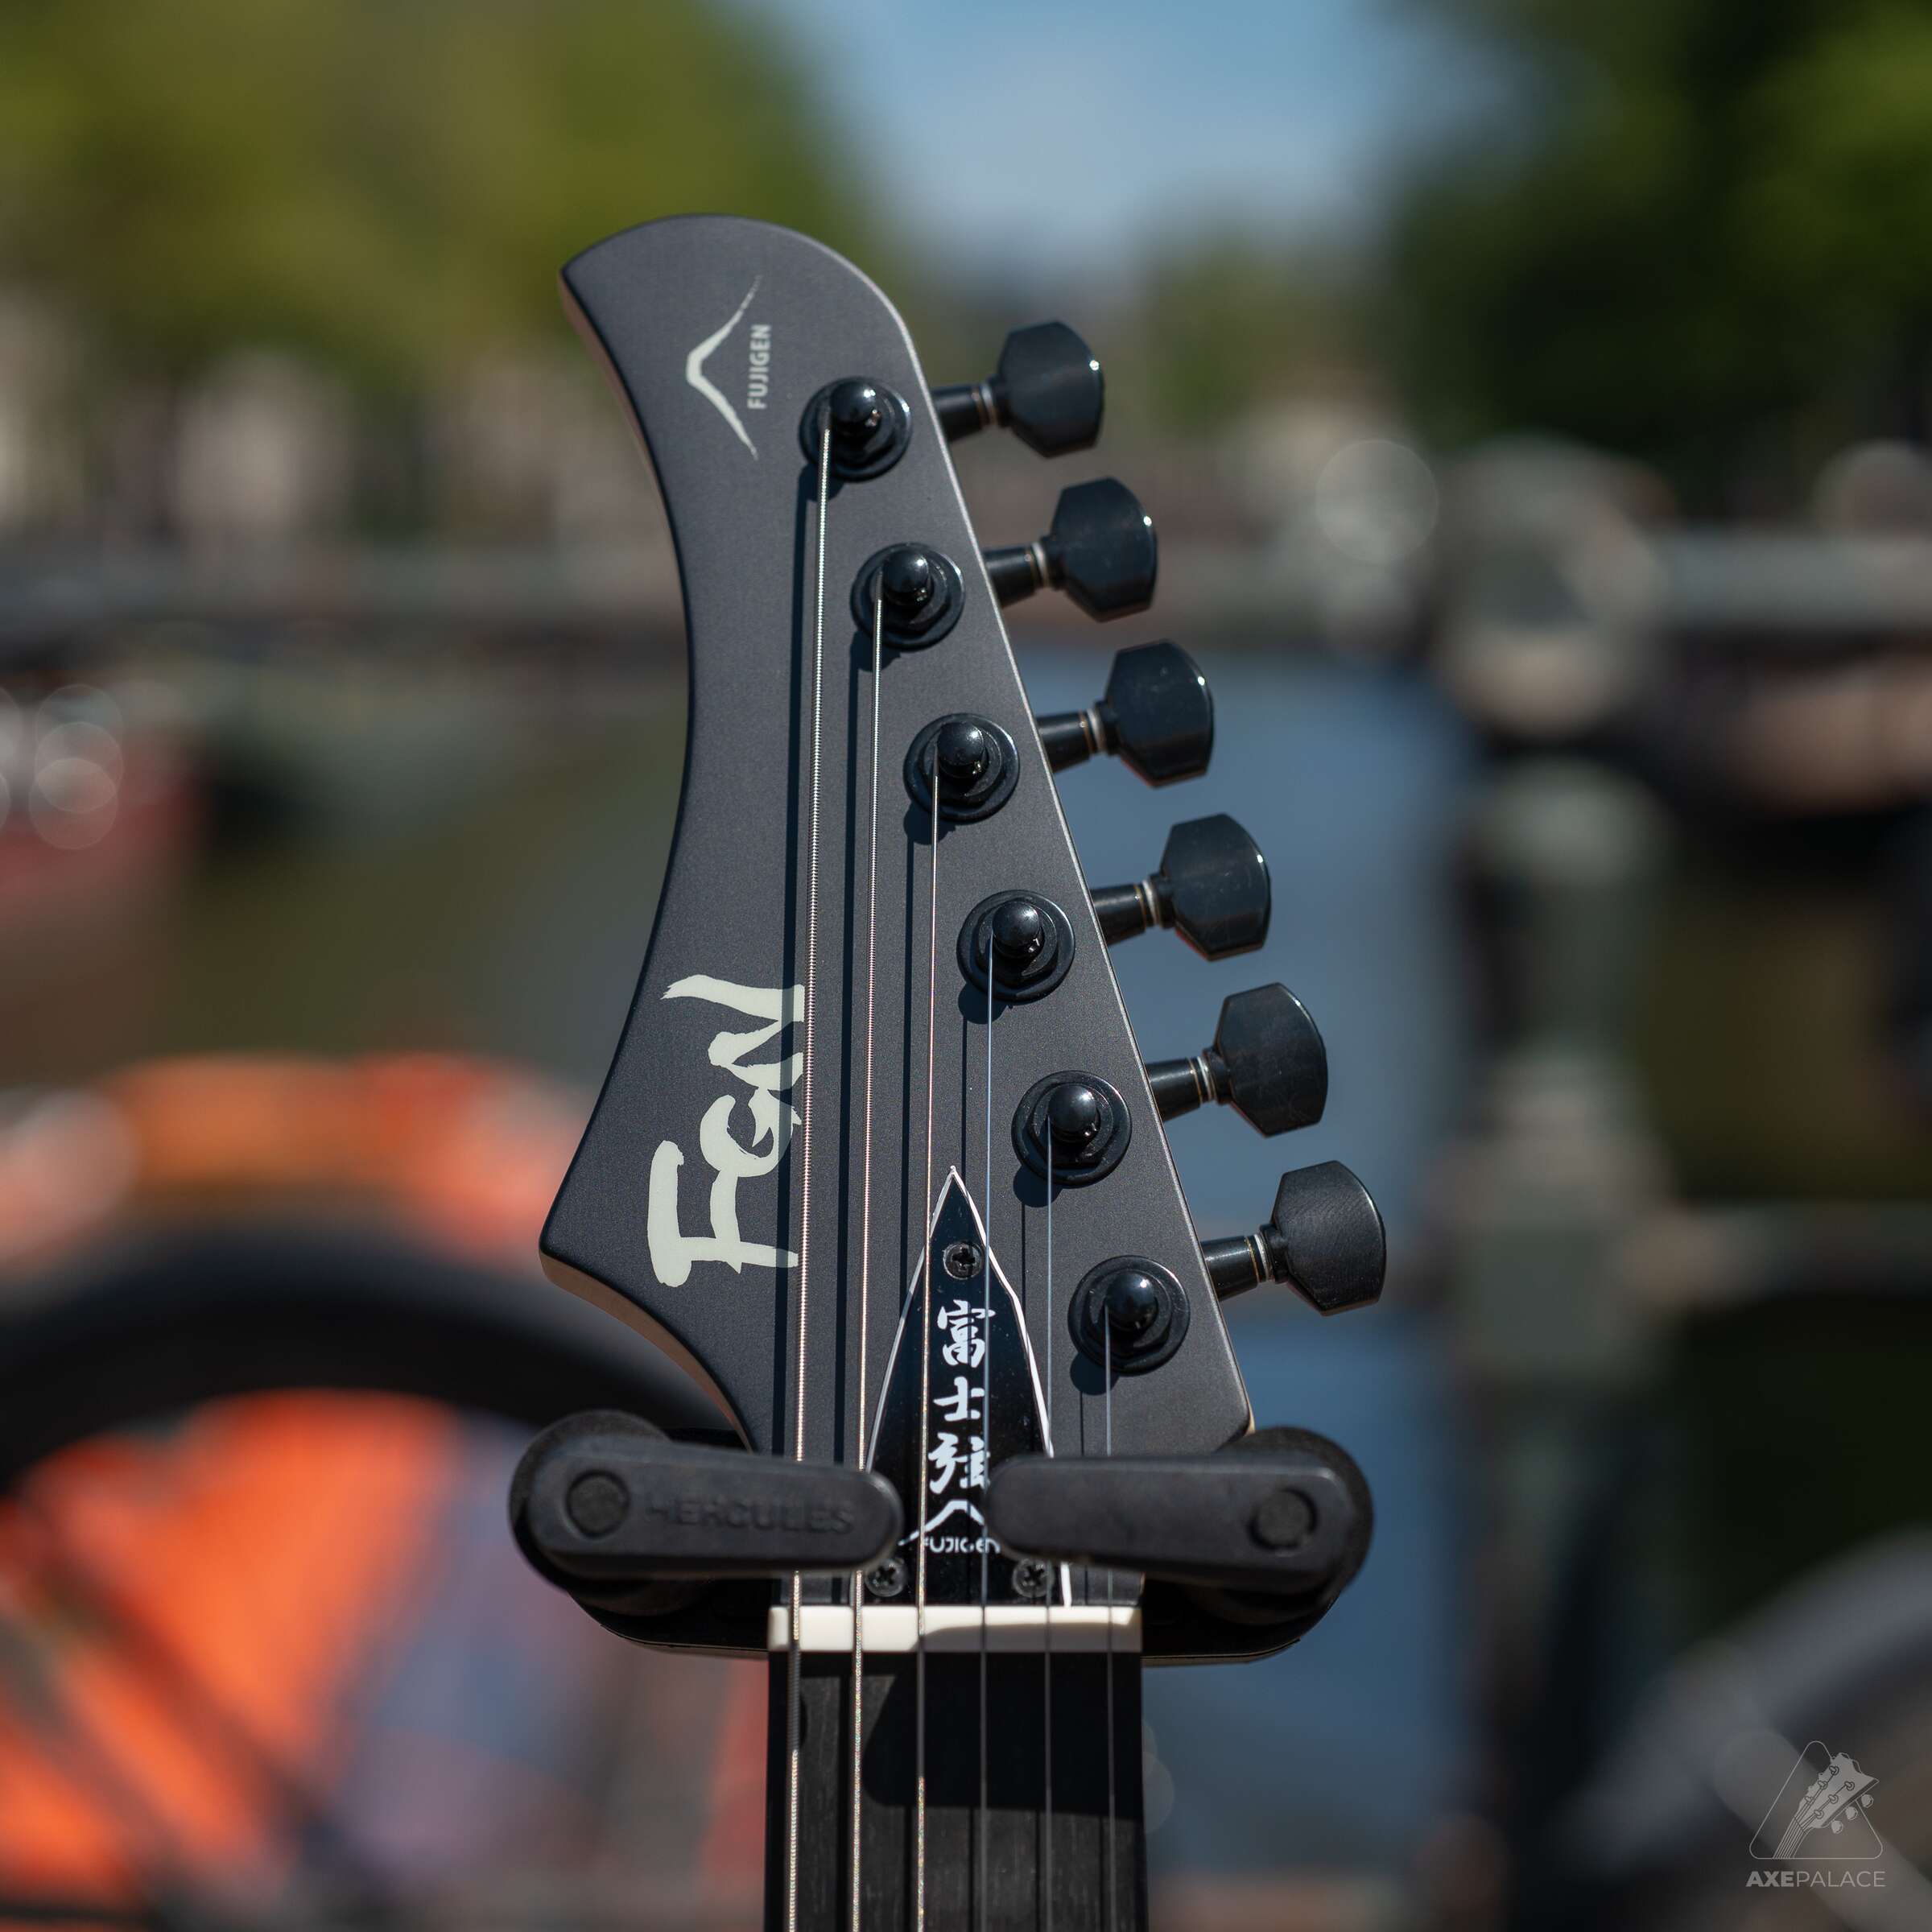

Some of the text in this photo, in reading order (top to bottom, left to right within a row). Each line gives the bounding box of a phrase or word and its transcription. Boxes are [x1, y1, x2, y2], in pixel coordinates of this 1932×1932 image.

[747, 324, 771, 409] FUJIGEN
[647, 974, 805, 1288] FGN
[645, 1494, 856, 1534] HERCULES
